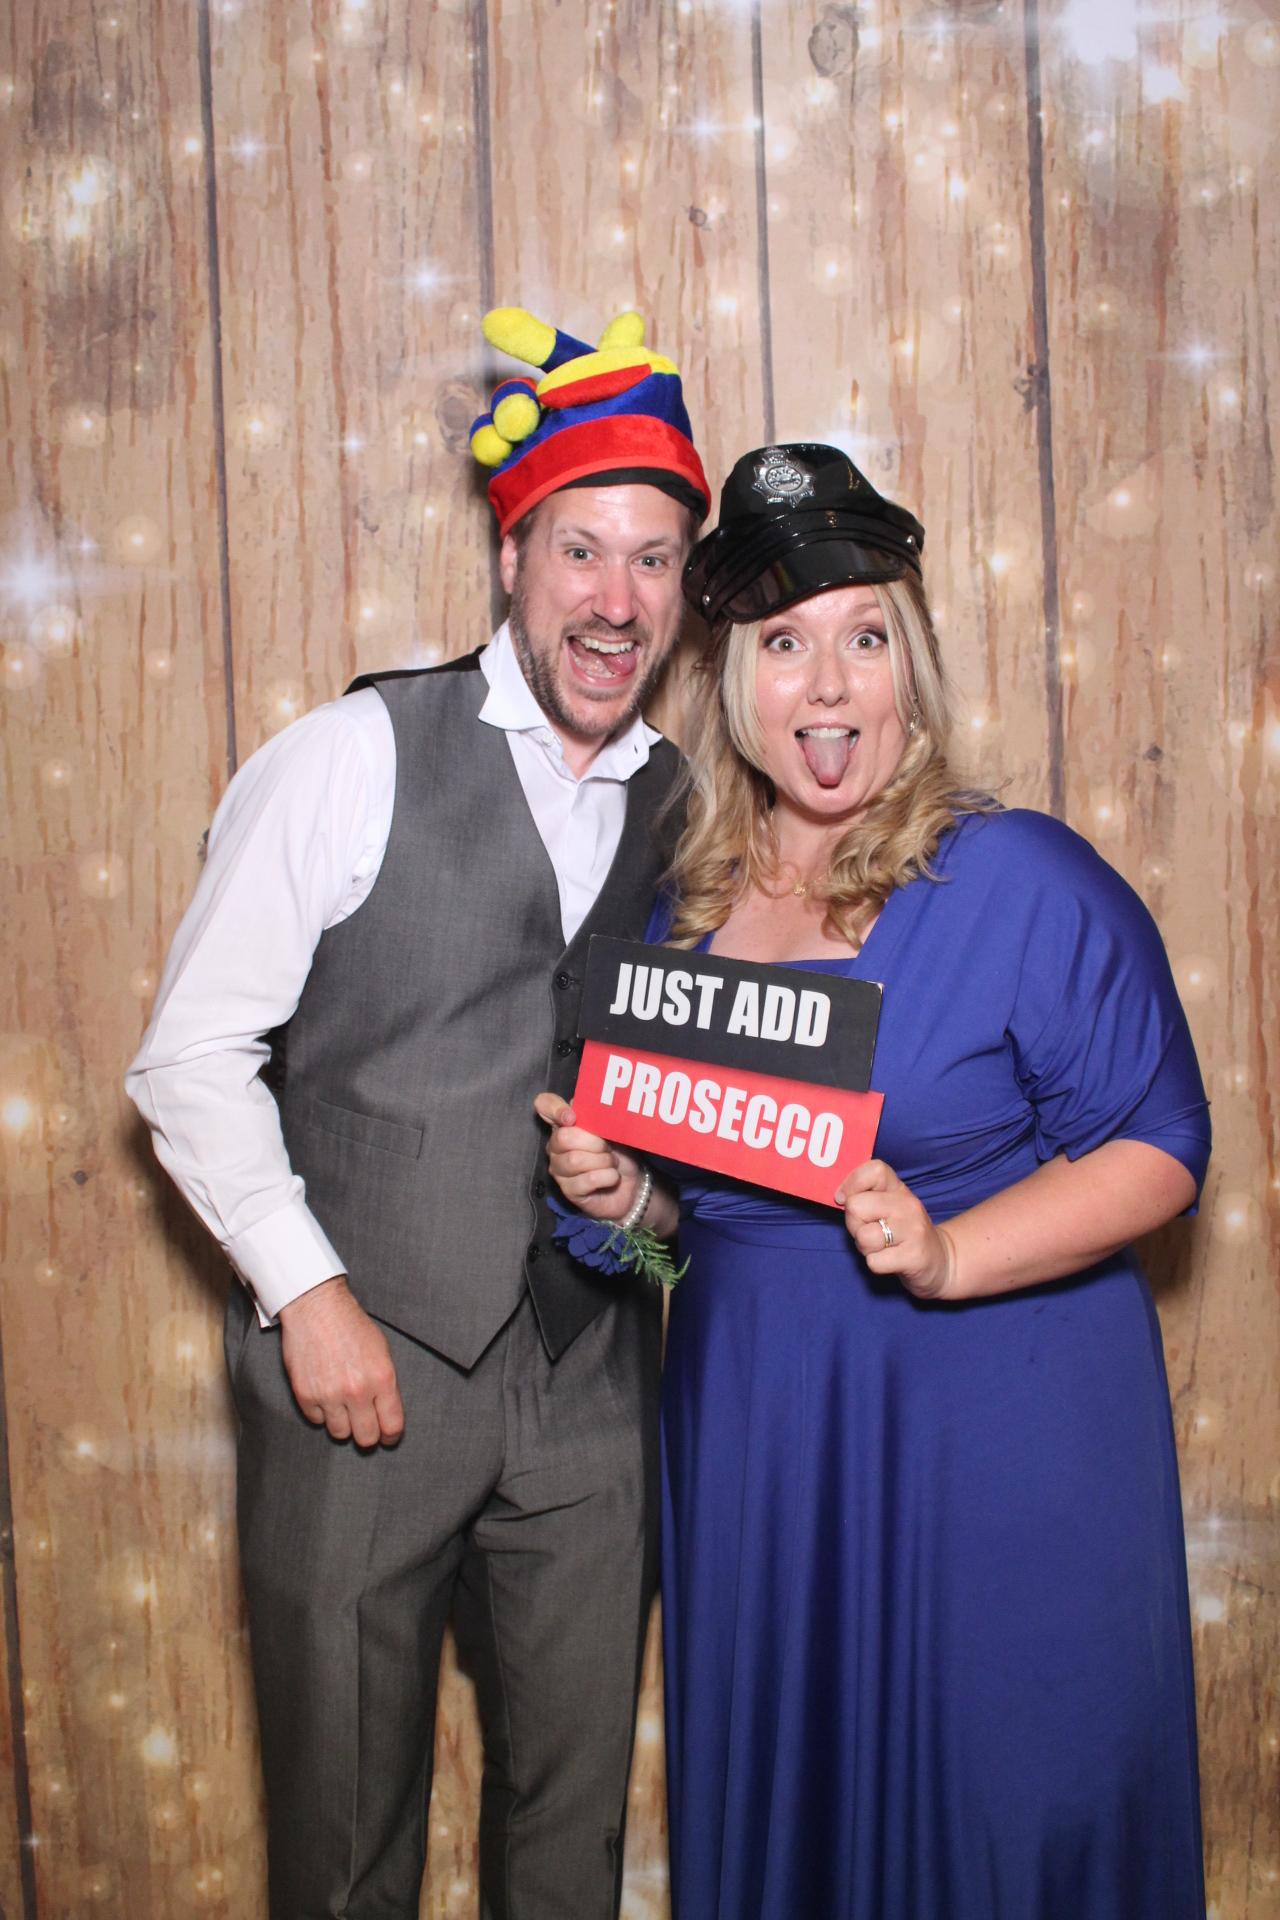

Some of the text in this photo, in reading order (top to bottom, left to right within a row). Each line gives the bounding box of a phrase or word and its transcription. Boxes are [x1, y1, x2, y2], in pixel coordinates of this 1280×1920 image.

[610, 962, 831, 1047] JUST ADD
[600, 1054, 844, 1168] PROSECCO
